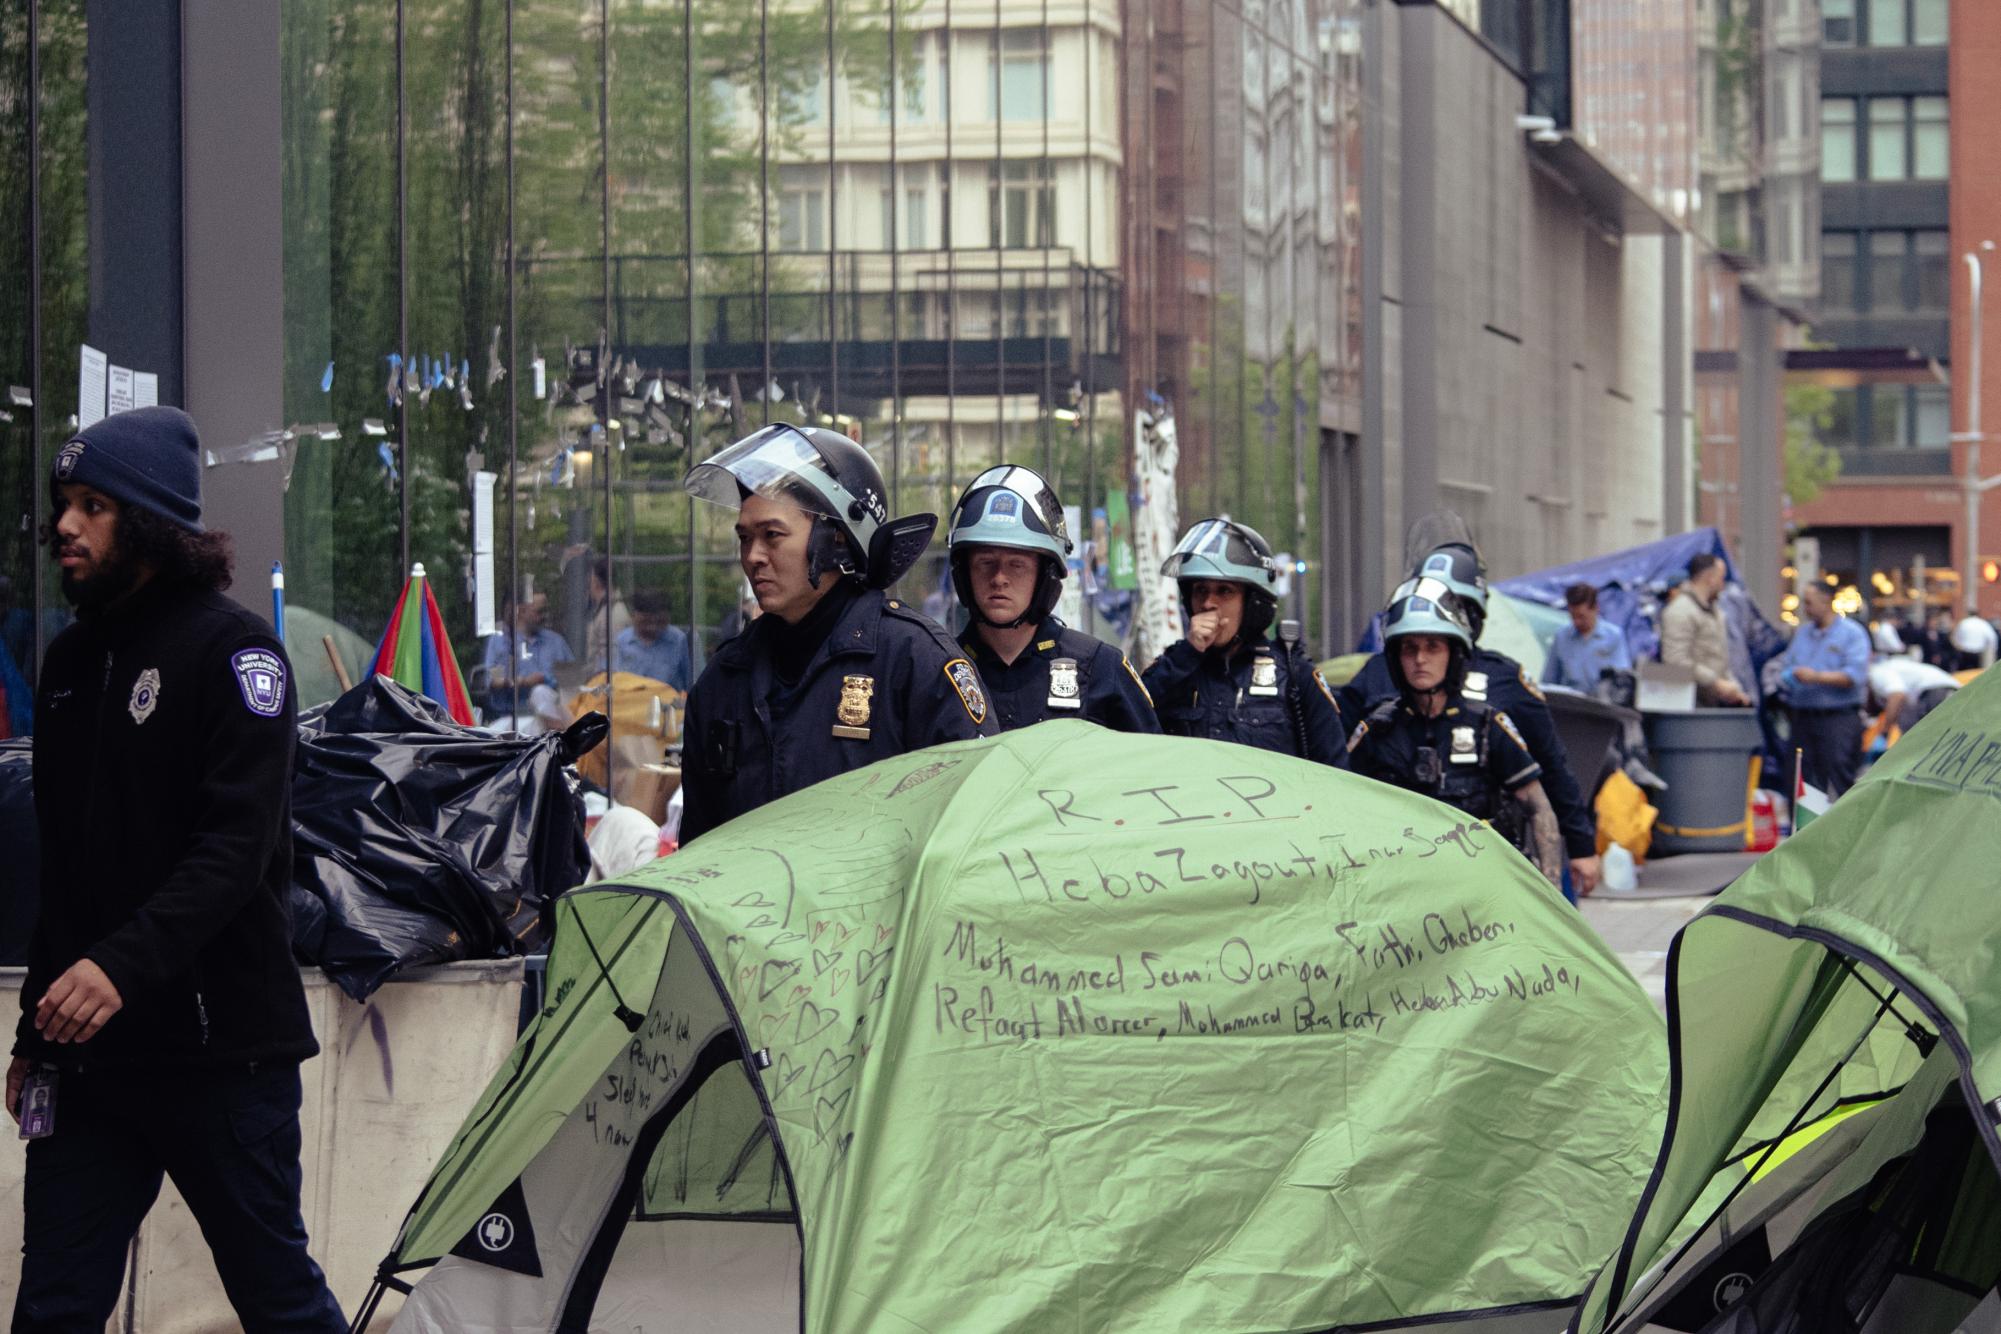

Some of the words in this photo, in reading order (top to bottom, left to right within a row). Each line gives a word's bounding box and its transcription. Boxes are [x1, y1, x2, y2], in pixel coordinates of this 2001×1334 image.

[237, 660, 284, 677] UNIVERSITY
[241, 653, 260, 662] NEW
[260, 653, 280, 668] YORK
[1036, 774, 1313, 828] R.I.P.
[998, 847, 1169, 906] Heba
[943, 920, 1125, 994] Mohammed
